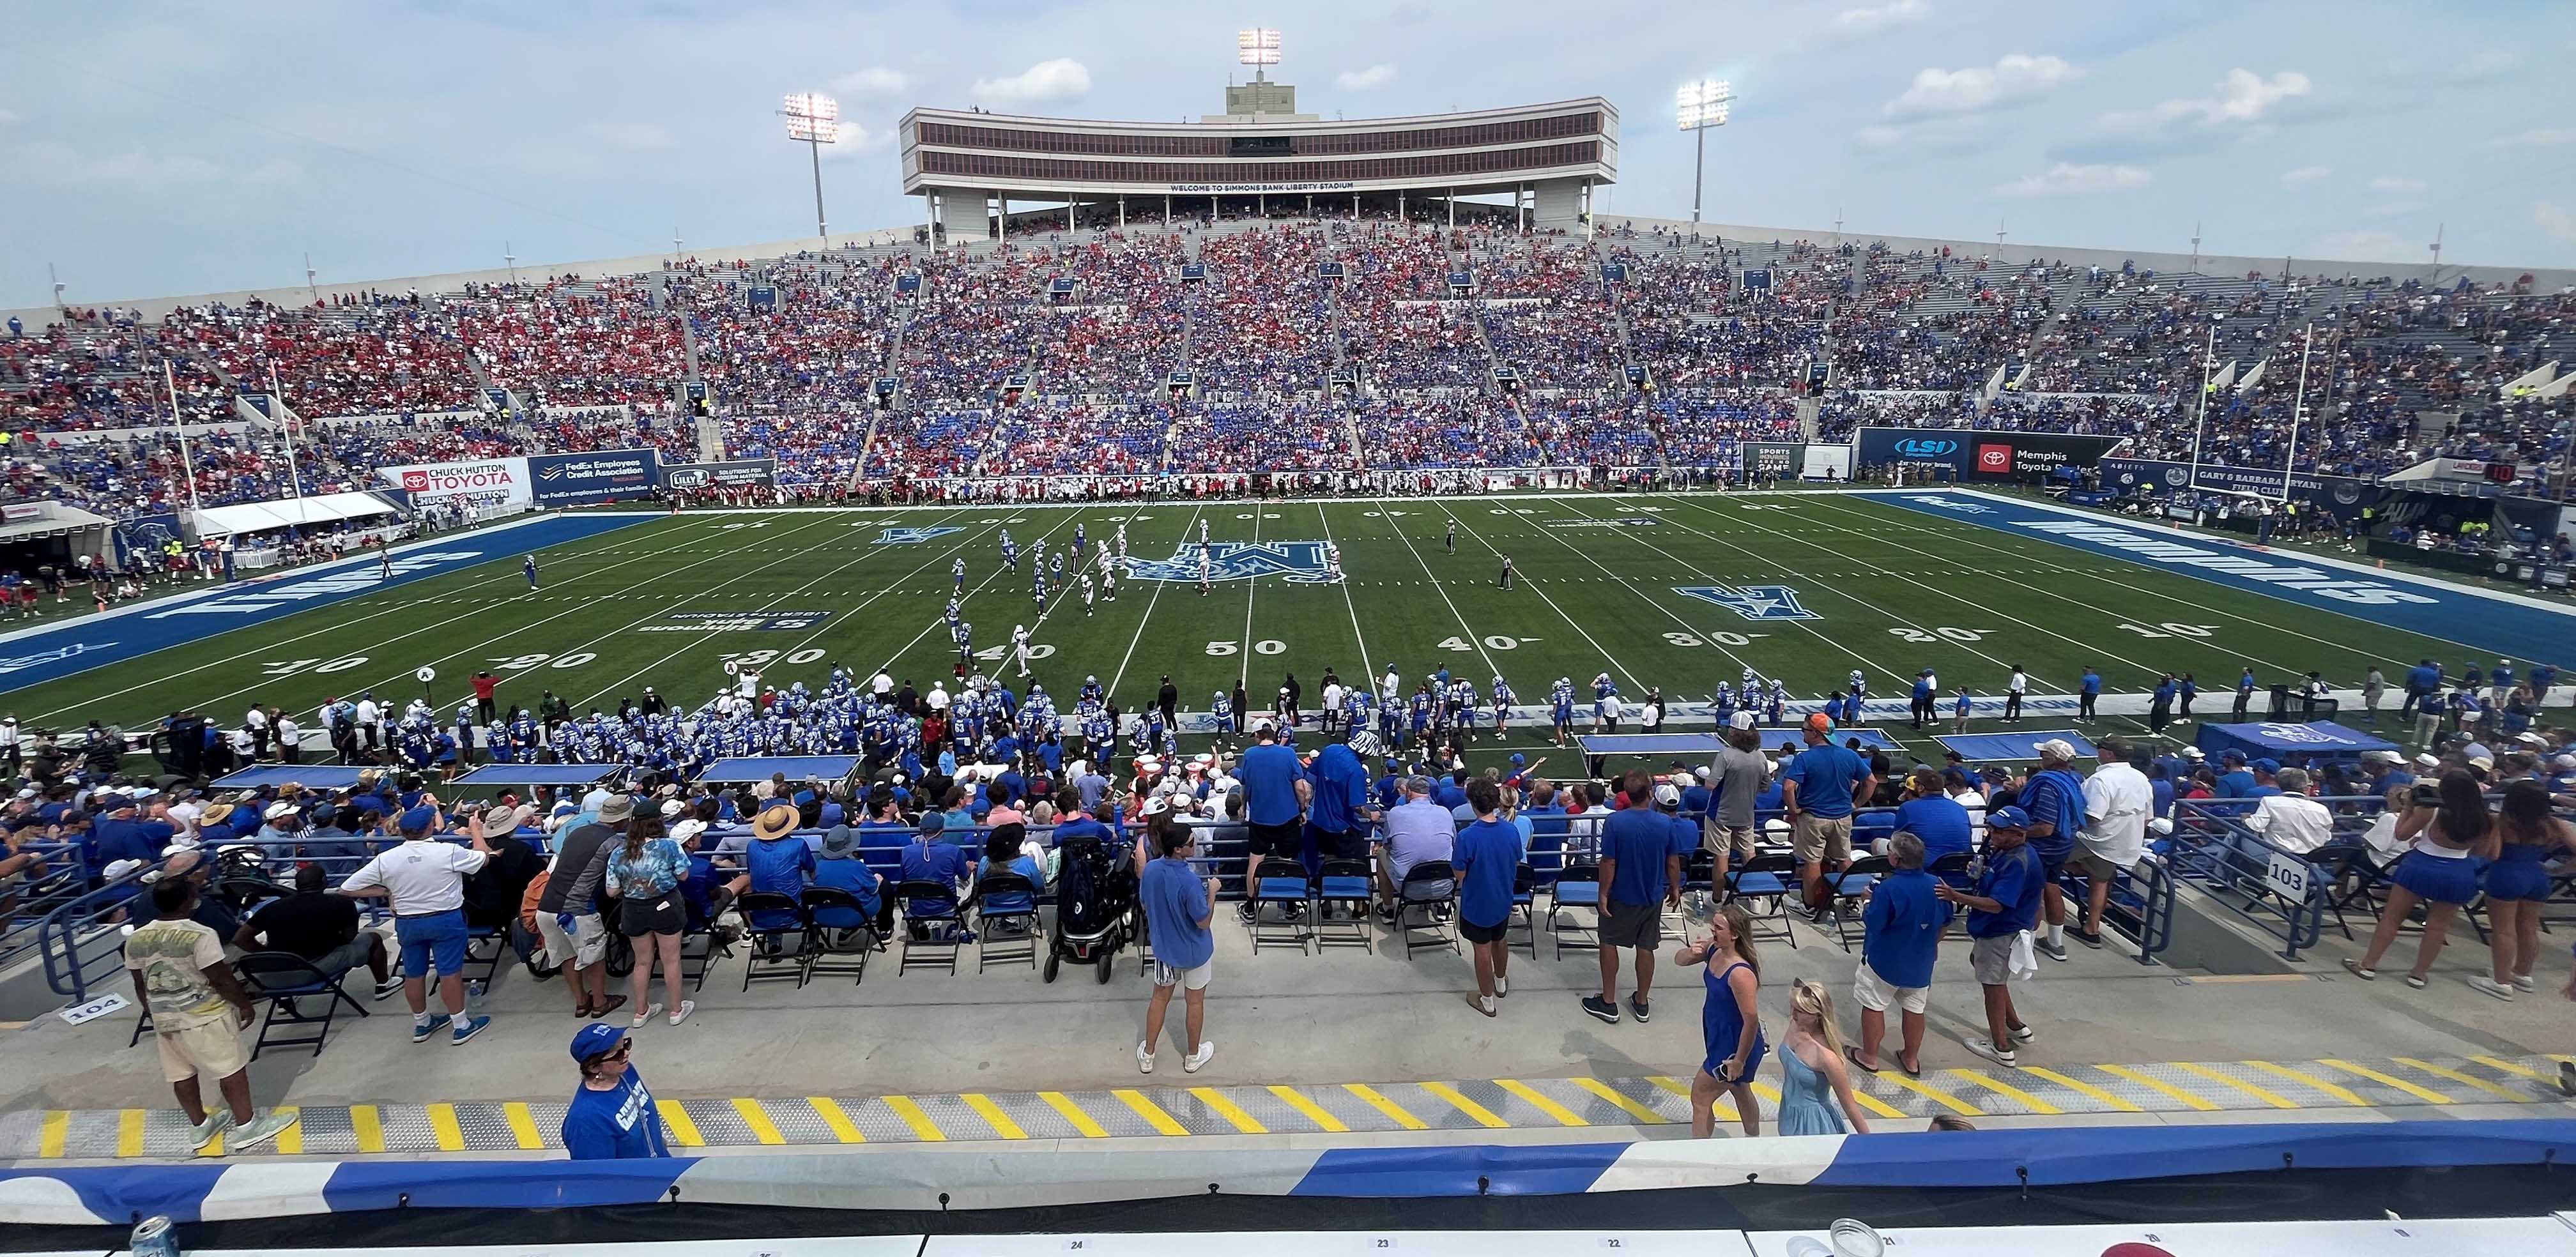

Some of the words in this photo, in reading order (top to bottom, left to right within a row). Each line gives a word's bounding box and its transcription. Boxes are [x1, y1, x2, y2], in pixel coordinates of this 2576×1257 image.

[1905, 440, 1946, 453] LSI
[2017, 450, 2067, 461] Memphis
[429, 468, 463, 478] CHUCK
[465, 464, 505, 475] HUTTON
[565, 461, 592, 471] FedEx
[594, 459, 640, 470] Employees
[2016, 461, 2052, 472] Toyota
[566, 471, 594, 480] Credit
[595, 467, 643, 477] Association
[430, 472, 513, 491] TOYOTA
[673, 476, 696, 485] LILLY
[2199, 471, 2226, 480] GARY
[2235, 474, 2282, 485] BARBARA
[2285, 479, 2323, 490] RYANT
[1889, 627, 1981, 643] 20
[2116, 622, 2213, 638] 10
[1438, 636, 1517, 651] 40
[1662, 632, 1749, 647] 30
[1206, 640, 1287, 655] 50
[2271, 862, 2303, 892] 103
[70, 998, 120, 1020] 104
[1071, 1241, 1083, 1249] 24
[1377, 1239, 1388, 1247] 23
[1607, 1239, 1620, 1247] 22
[1882, 1237, 1895, 1245] 21
